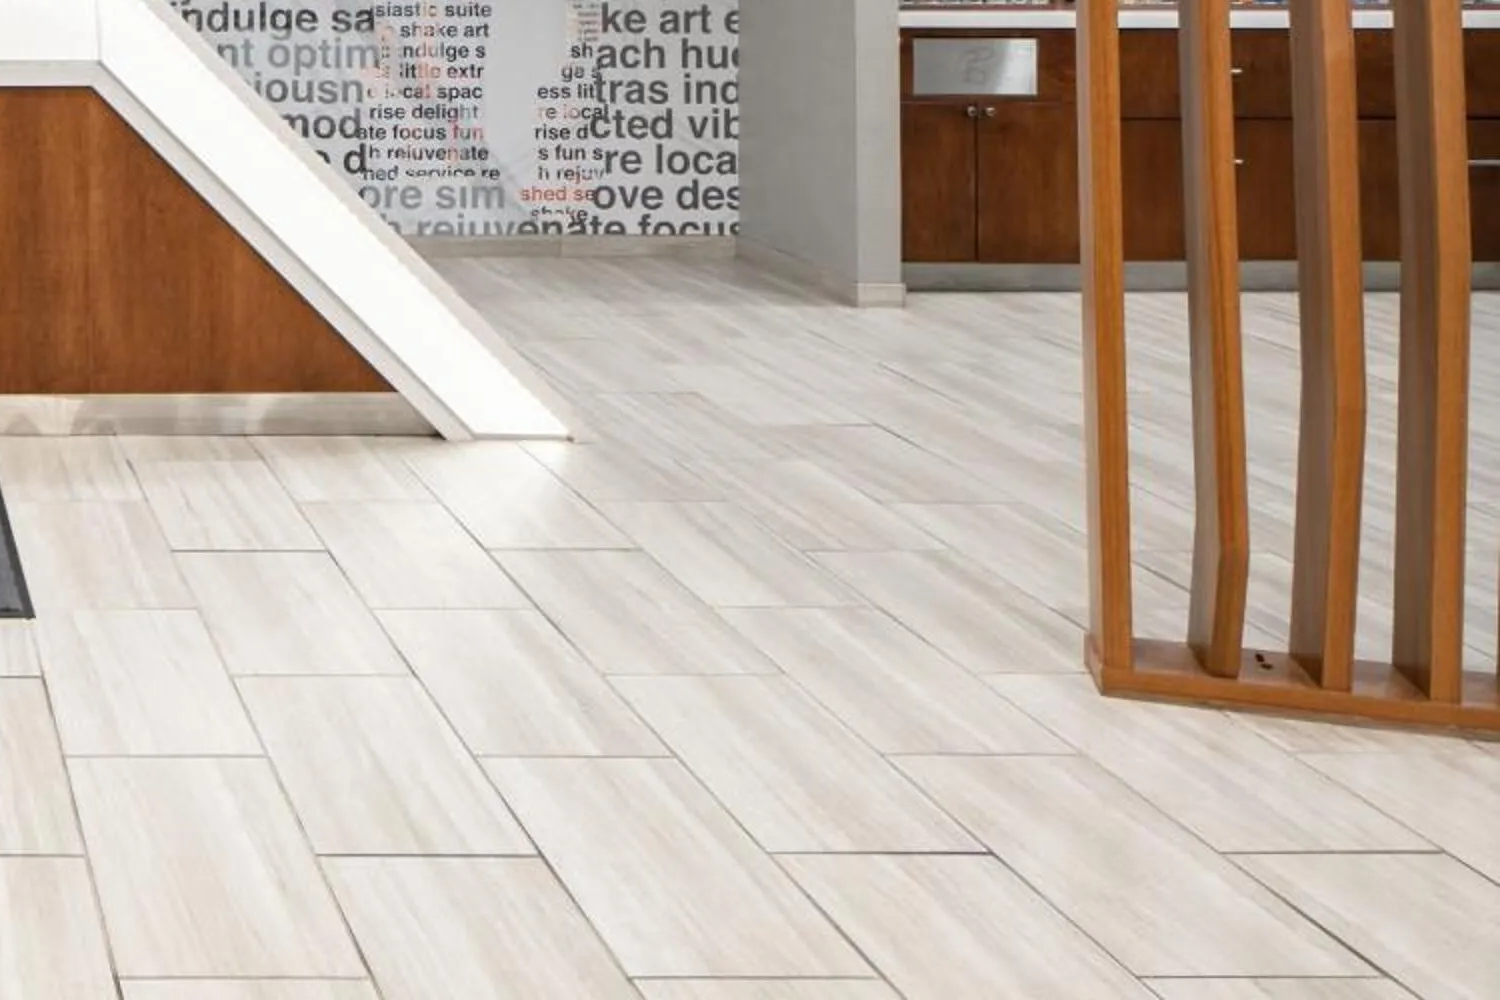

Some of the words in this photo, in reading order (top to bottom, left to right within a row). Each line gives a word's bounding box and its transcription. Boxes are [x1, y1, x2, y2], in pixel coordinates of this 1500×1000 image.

[445, 2, 493, 18] suite
[601, 2, 647, 34] ke
[659, 4, 712, 34] art
[171, 1, 319, 39] ndulge
[331, 7, 375, 33] sa
[463, 23, 490, 38] art
[267, 37, 379, 76] optim
[596, 38, 665, 69] ach
[447, 64, 485, 79] extr
[437, 86, 484, 101] spac
[537, 85, 571, 100] ess
[369, 106, 406, 120] rise
[411, 104, 479, 122] delight
[393, 124, 447, 140] focus
[535, 125, 571, 140] rise
[590, 108, 673, 140] cted
[555, 144, 586, 161] fun
[656, 143, 738, 175] loca
